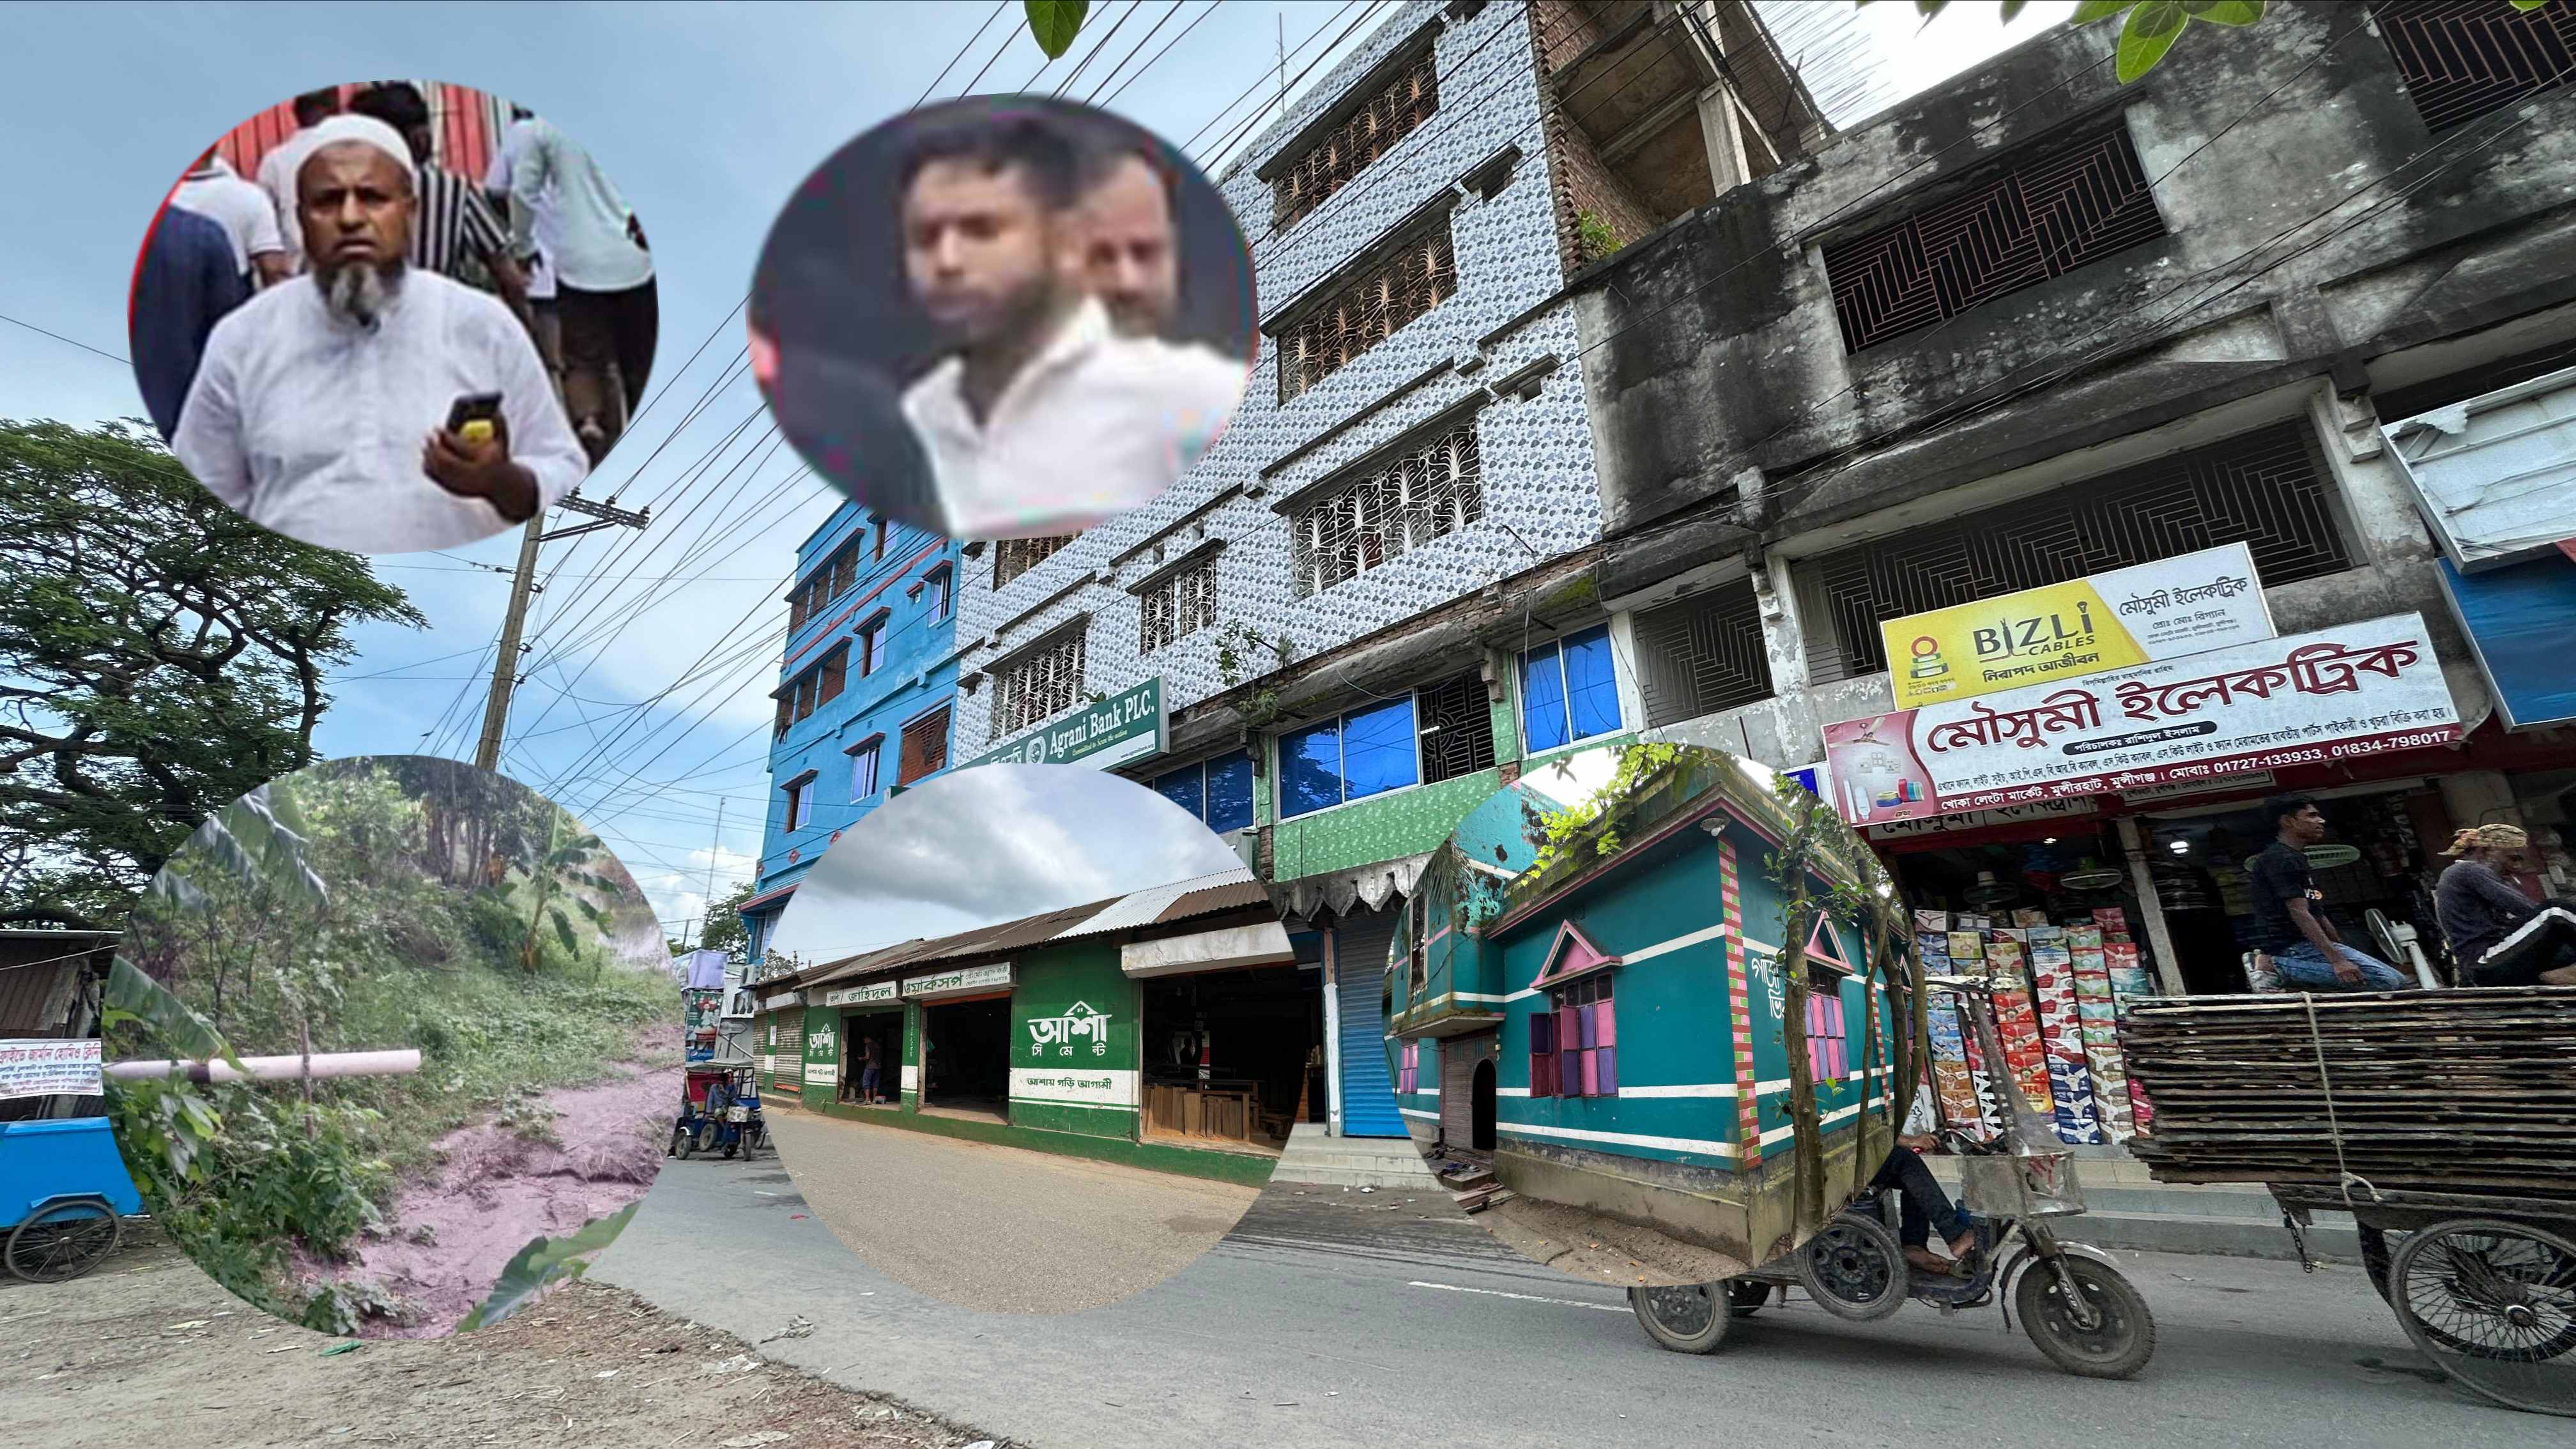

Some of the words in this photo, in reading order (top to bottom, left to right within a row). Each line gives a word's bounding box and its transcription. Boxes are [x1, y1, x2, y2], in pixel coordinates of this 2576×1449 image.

[2119, 590, 2170, 615] মৌসুমী
[2172, 576, 2248, 605] ইলেকট্রিক
[2174, 615, 2193, 625] মোঃ
[2028, 636, 2096, 656] CABLES
[1983, 664, 2035, 683] নিরাপদ
[2039, 651, 2100, 674] আজীবন
[1927, 689, 2101, 752] মৌসুমী
[2116, 641, 2420, 721] ইলেকট্রিক
[1050, 716, 1087, 759] Agrani
[1090, 703, 1122, 739] Bank
[1124, 689, 1154, 724] PLC.
[2074, 739, 2122, 753] পরিচালকঃ
[2125, 732, 2161, 744] রাশিদুল
[2164, 725, 2200, 737] ইসলাম
[2186, 741, 2205, 755] লাইট
[2206, 743, 2214, 751] ও
[2234, 733, 2271, 748] মেরামতের
[2271, 726, 2301, 741] যাবতীয়
[2325, 717, 2358, 734] পাইকারী
[2359, 719, 2368, 728] ও
[2412, 710, 2432, 721] করা
[1941, 797, 1970, 810] খোকা
[1974, 792, 2005, 806] লেংটা
[2007, 786, 2048, 801] মার্কেট,
[2170, 765, 2210, 779] মোবাঃ
[2214, 748, 2327, 774] 01727-133933,
[2332, 730, 2451, 756] 01834-798017
[848, 986, 892, 1002] জাহিদুল
[903, 972, 963, 994] ওয়ার্কসপ
[809, 1030, 836, 1048] আশা
[1027, 1012, 1113, 1044] আশা
[54, 1043, 81, 1061] হোমিও
[1027, 1078, 1055, 1087] আশায়
[1057, 1077, 1075, 1089] গড়ি
[1078, 1078, 1113, 1089] আগামী
